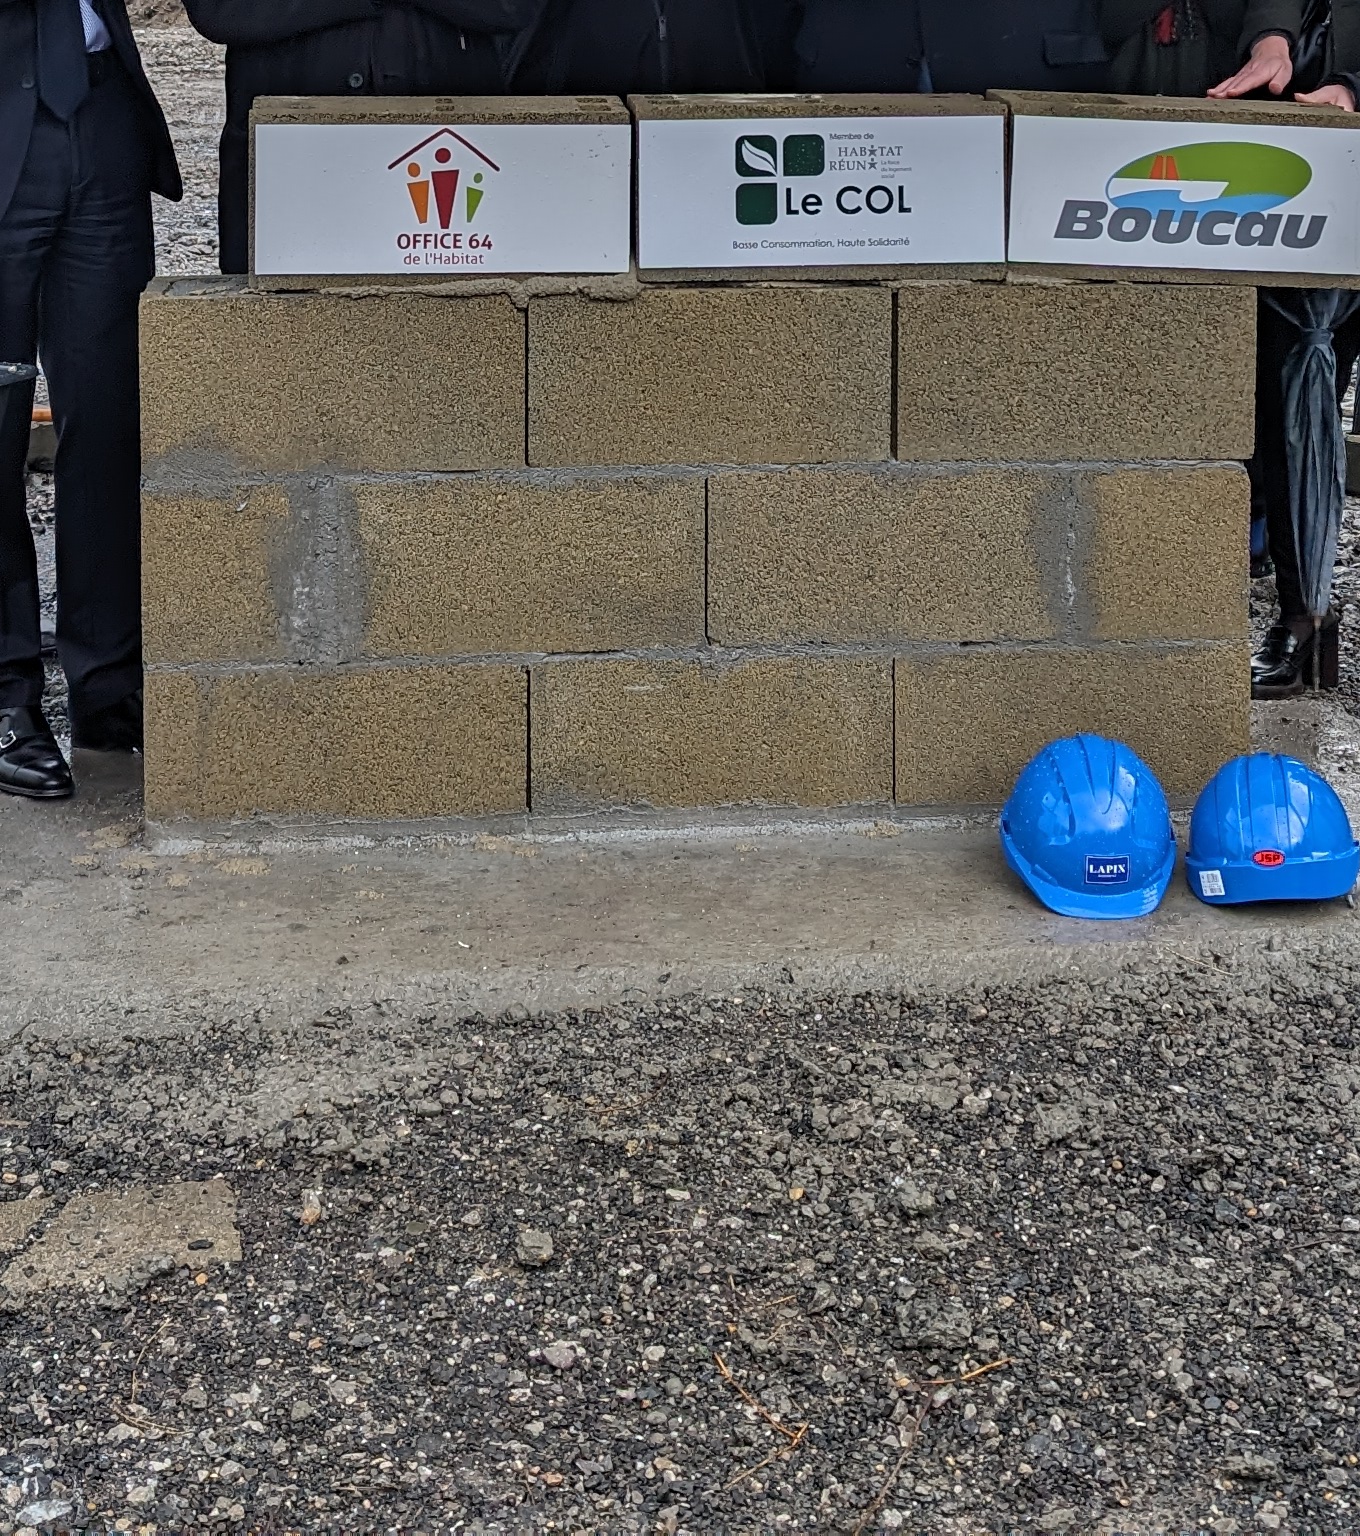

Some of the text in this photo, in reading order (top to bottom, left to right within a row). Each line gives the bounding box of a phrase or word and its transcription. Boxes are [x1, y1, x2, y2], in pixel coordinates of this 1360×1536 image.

[863, 132, 874, 140] de
[785, 185, 912, 215] Le COL
[1053, 199, 1329, 249] Boucau
[397, 233, 493, 250] OFFICE 64
[732, 236, 910, 250] Basse Consommation, Haute Solidarité
[403, 252, 485, 265] de l'Habitat
[1258, 853, 1281, 863] JSP
[1090, 864, 1125, 874] LAPIX
